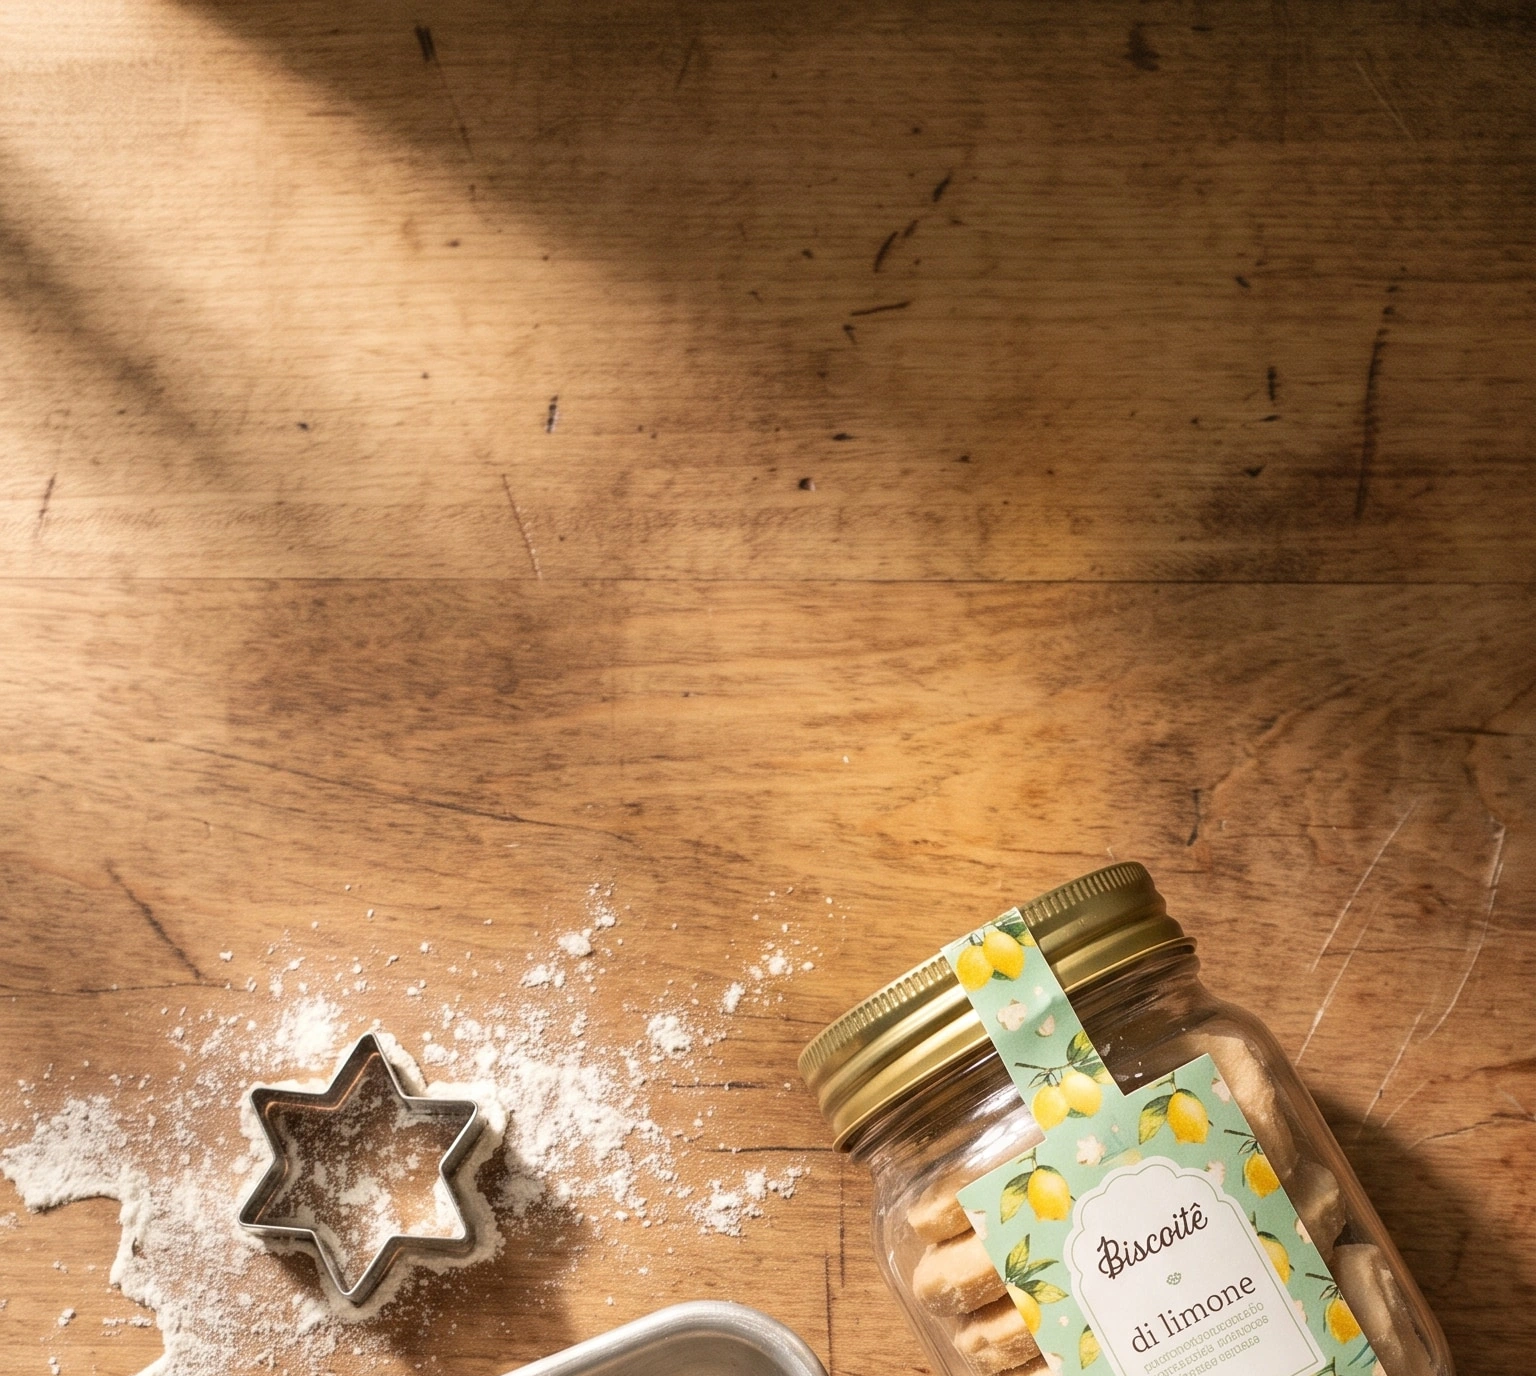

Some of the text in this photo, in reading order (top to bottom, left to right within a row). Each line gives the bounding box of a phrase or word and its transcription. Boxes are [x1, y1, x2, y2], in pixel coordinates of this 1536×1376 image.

[1097, 1202, 1208, 1279] Biscoitê
[1132, 1322, 1160, 1353] di
[1157, 1276, 1256, 1338] limone
